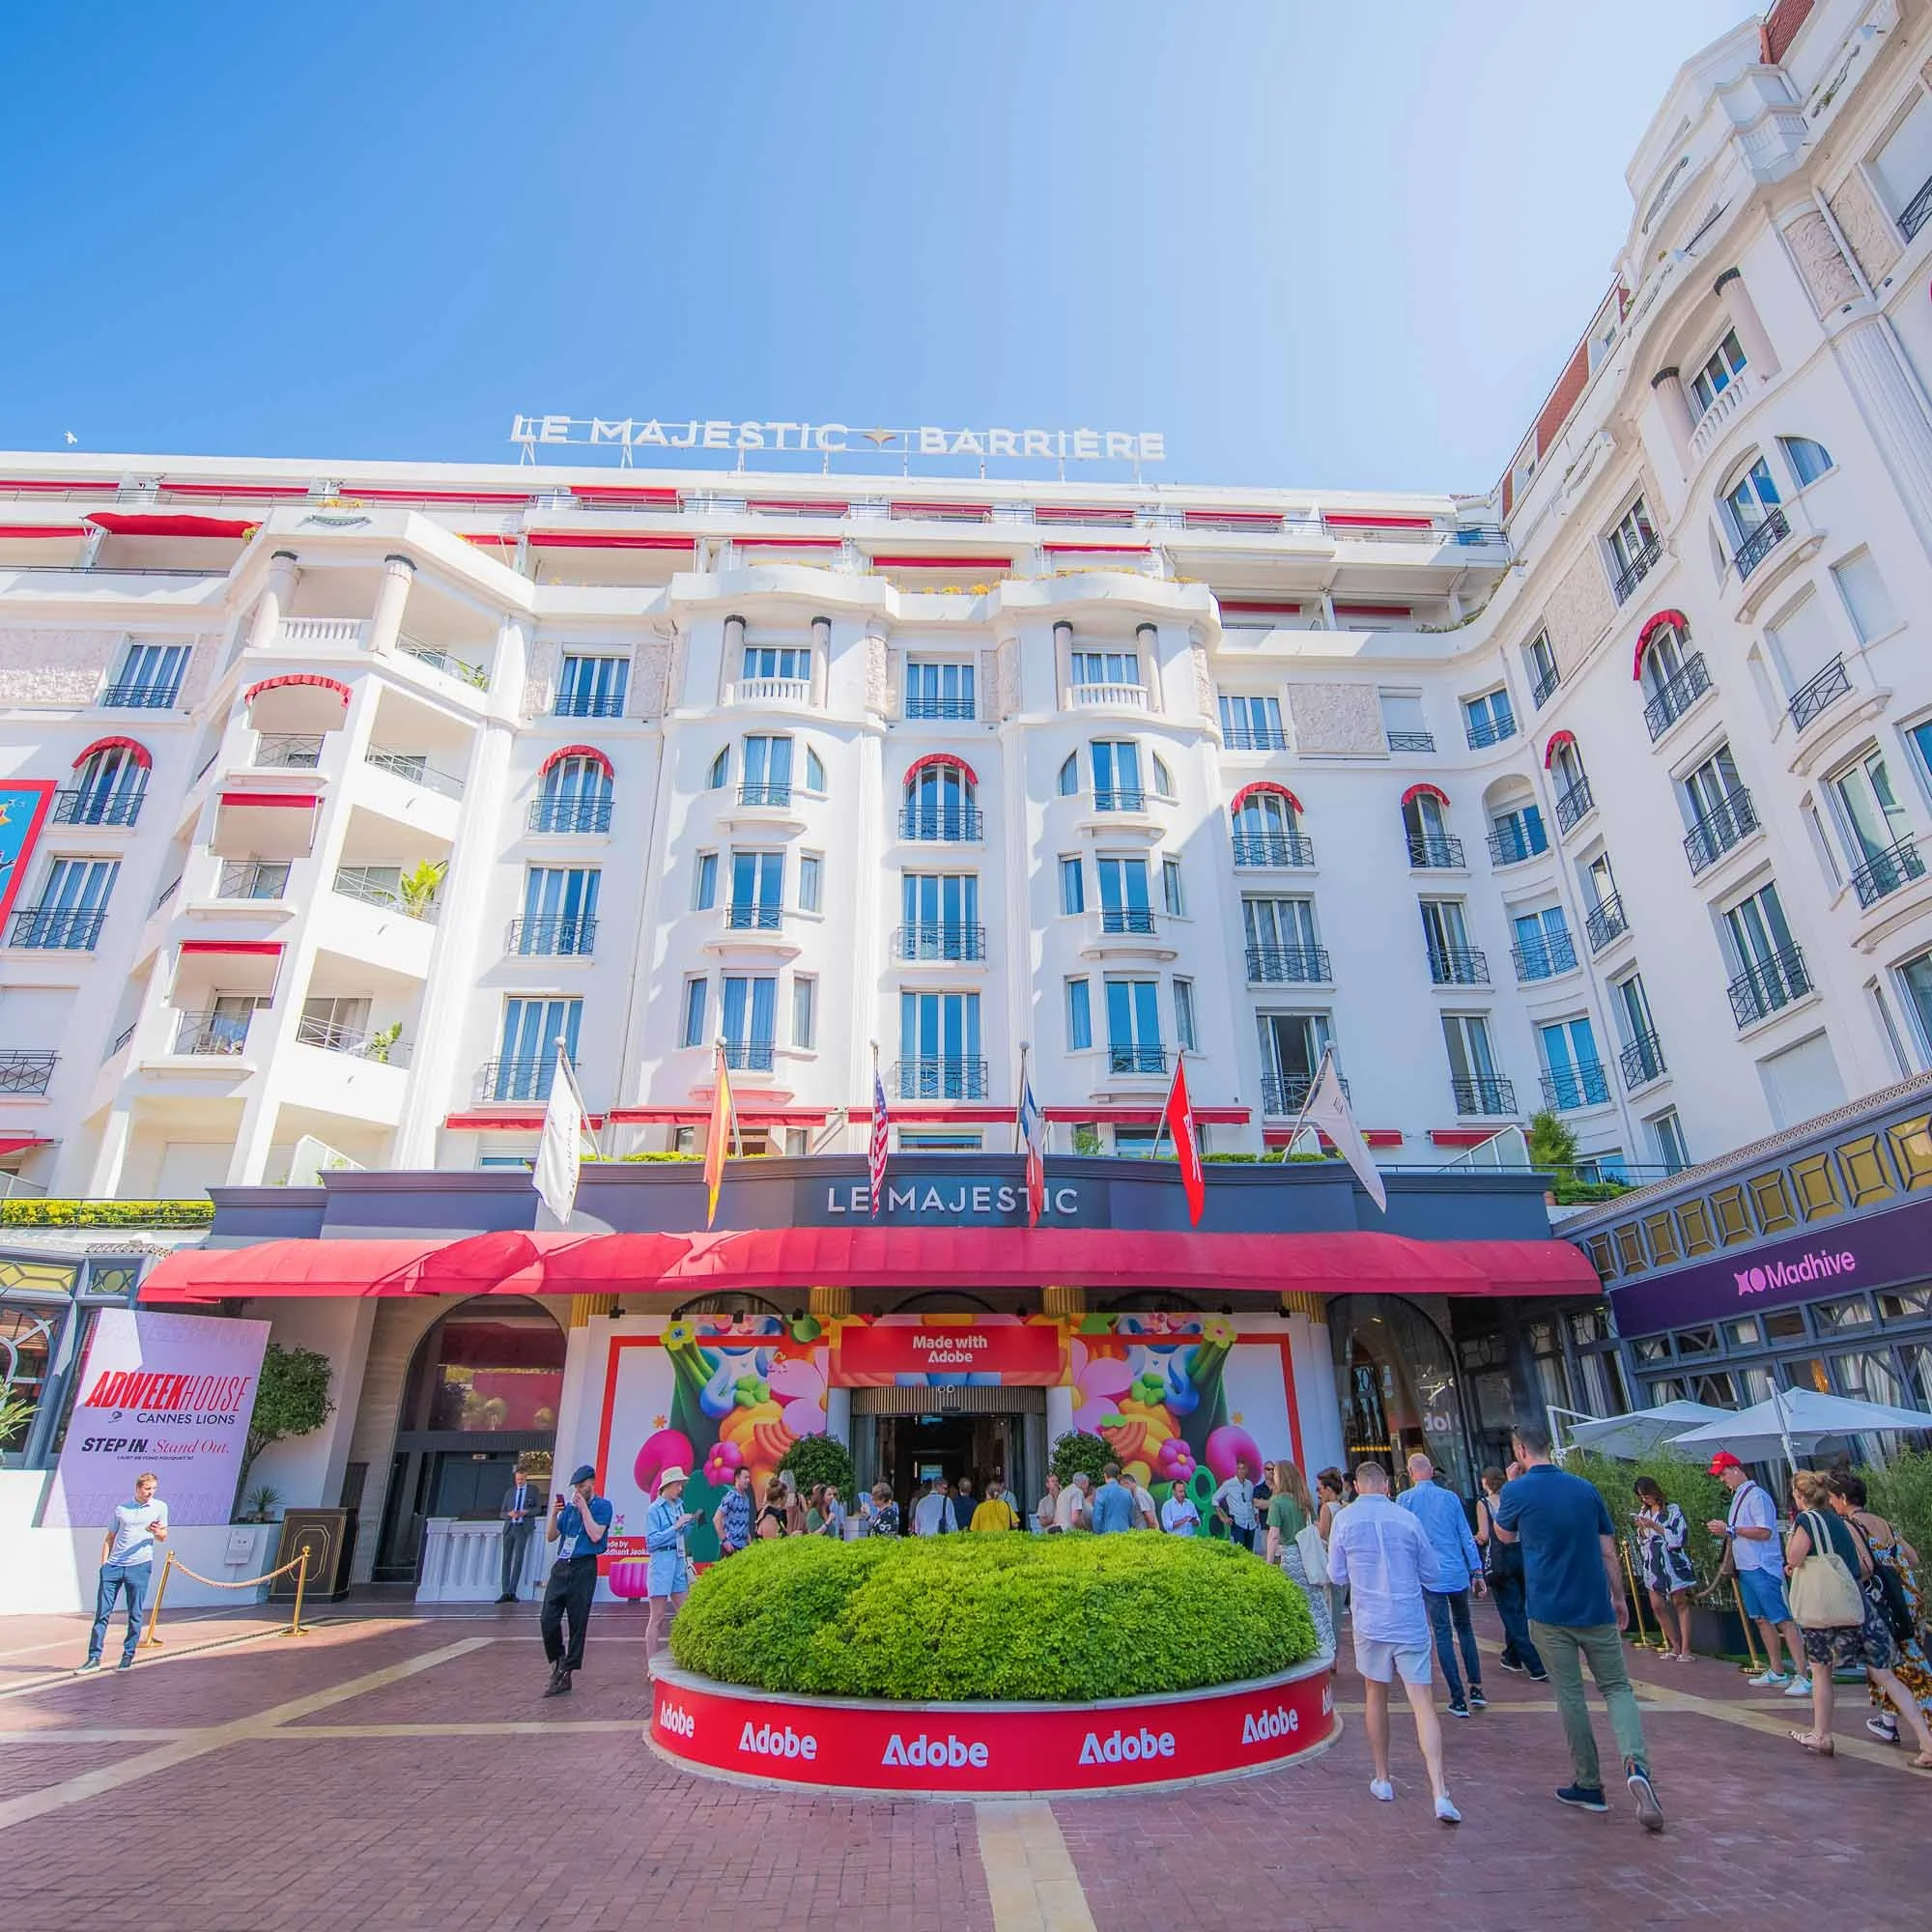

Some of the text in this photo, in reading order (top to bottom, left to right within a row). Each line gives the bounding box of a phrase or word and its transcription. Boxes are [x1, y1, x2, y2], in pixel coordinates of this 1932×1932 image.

[511, 415, 1167, 462] LE MAJESTIC BARRIÈRE
[827, 1186, 1078, 1214] LE MAJESTIC
[1764, 1249, 1856, 1290] Madhive
[913, 1335, 988, 1350] Made with
[927, 1350, 974, 1364] Adobe
[136, 1412, 236, 1426] CANNES LIONS
[81, 1437, 128, 1453] STEP
[153, 1438, 199, 1454] Stand
[619, 1540, 629, 1548] by
[660, 1699, 695, 1739] Adobe
[1241, 1705, 1299, 1746] Adobe
[738, 1721, 818, 1761] Adobe
[881, 1734, 989, 1769] Adobe
[1077, 1727, 1177, 1766] Adobe
